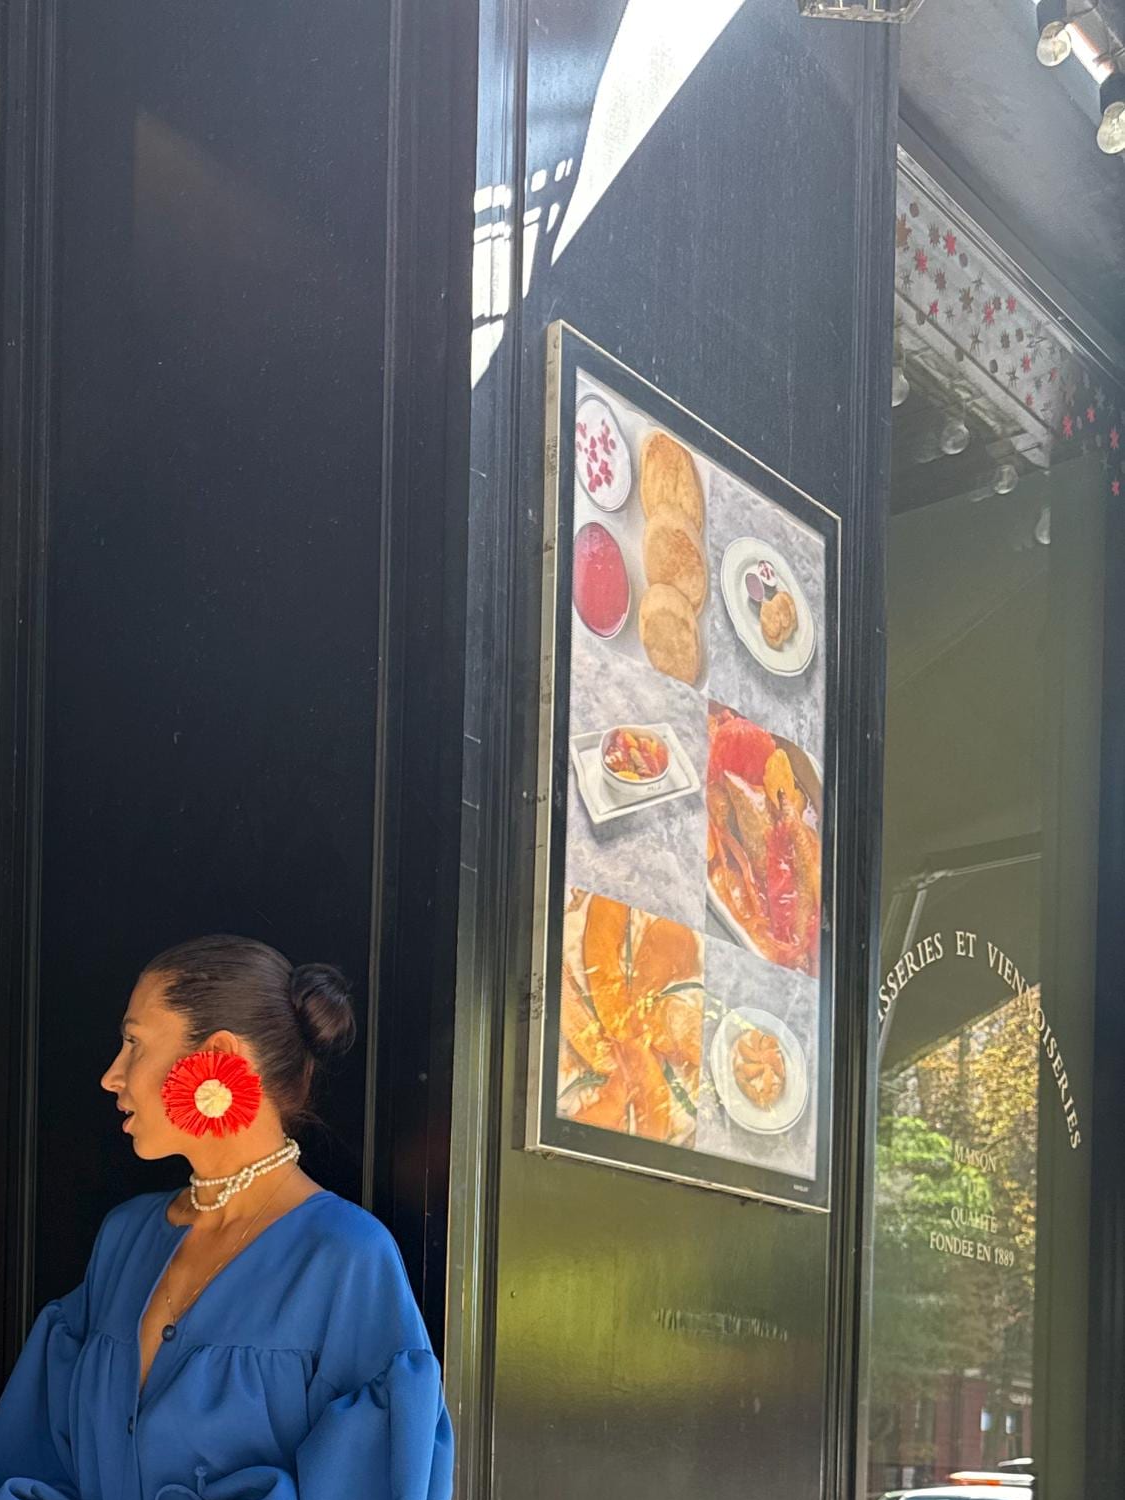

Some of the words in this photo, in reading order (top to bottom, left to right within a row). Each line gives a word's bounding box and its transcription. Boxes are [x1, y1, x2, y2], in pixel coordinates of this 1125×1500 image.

[955, 930, 977, 958] ET
[954, 1144, 997, 1172] MAISON
[976, 1243, 992, 1262] EN
[994, 1247, 1015, 1267] 1889
